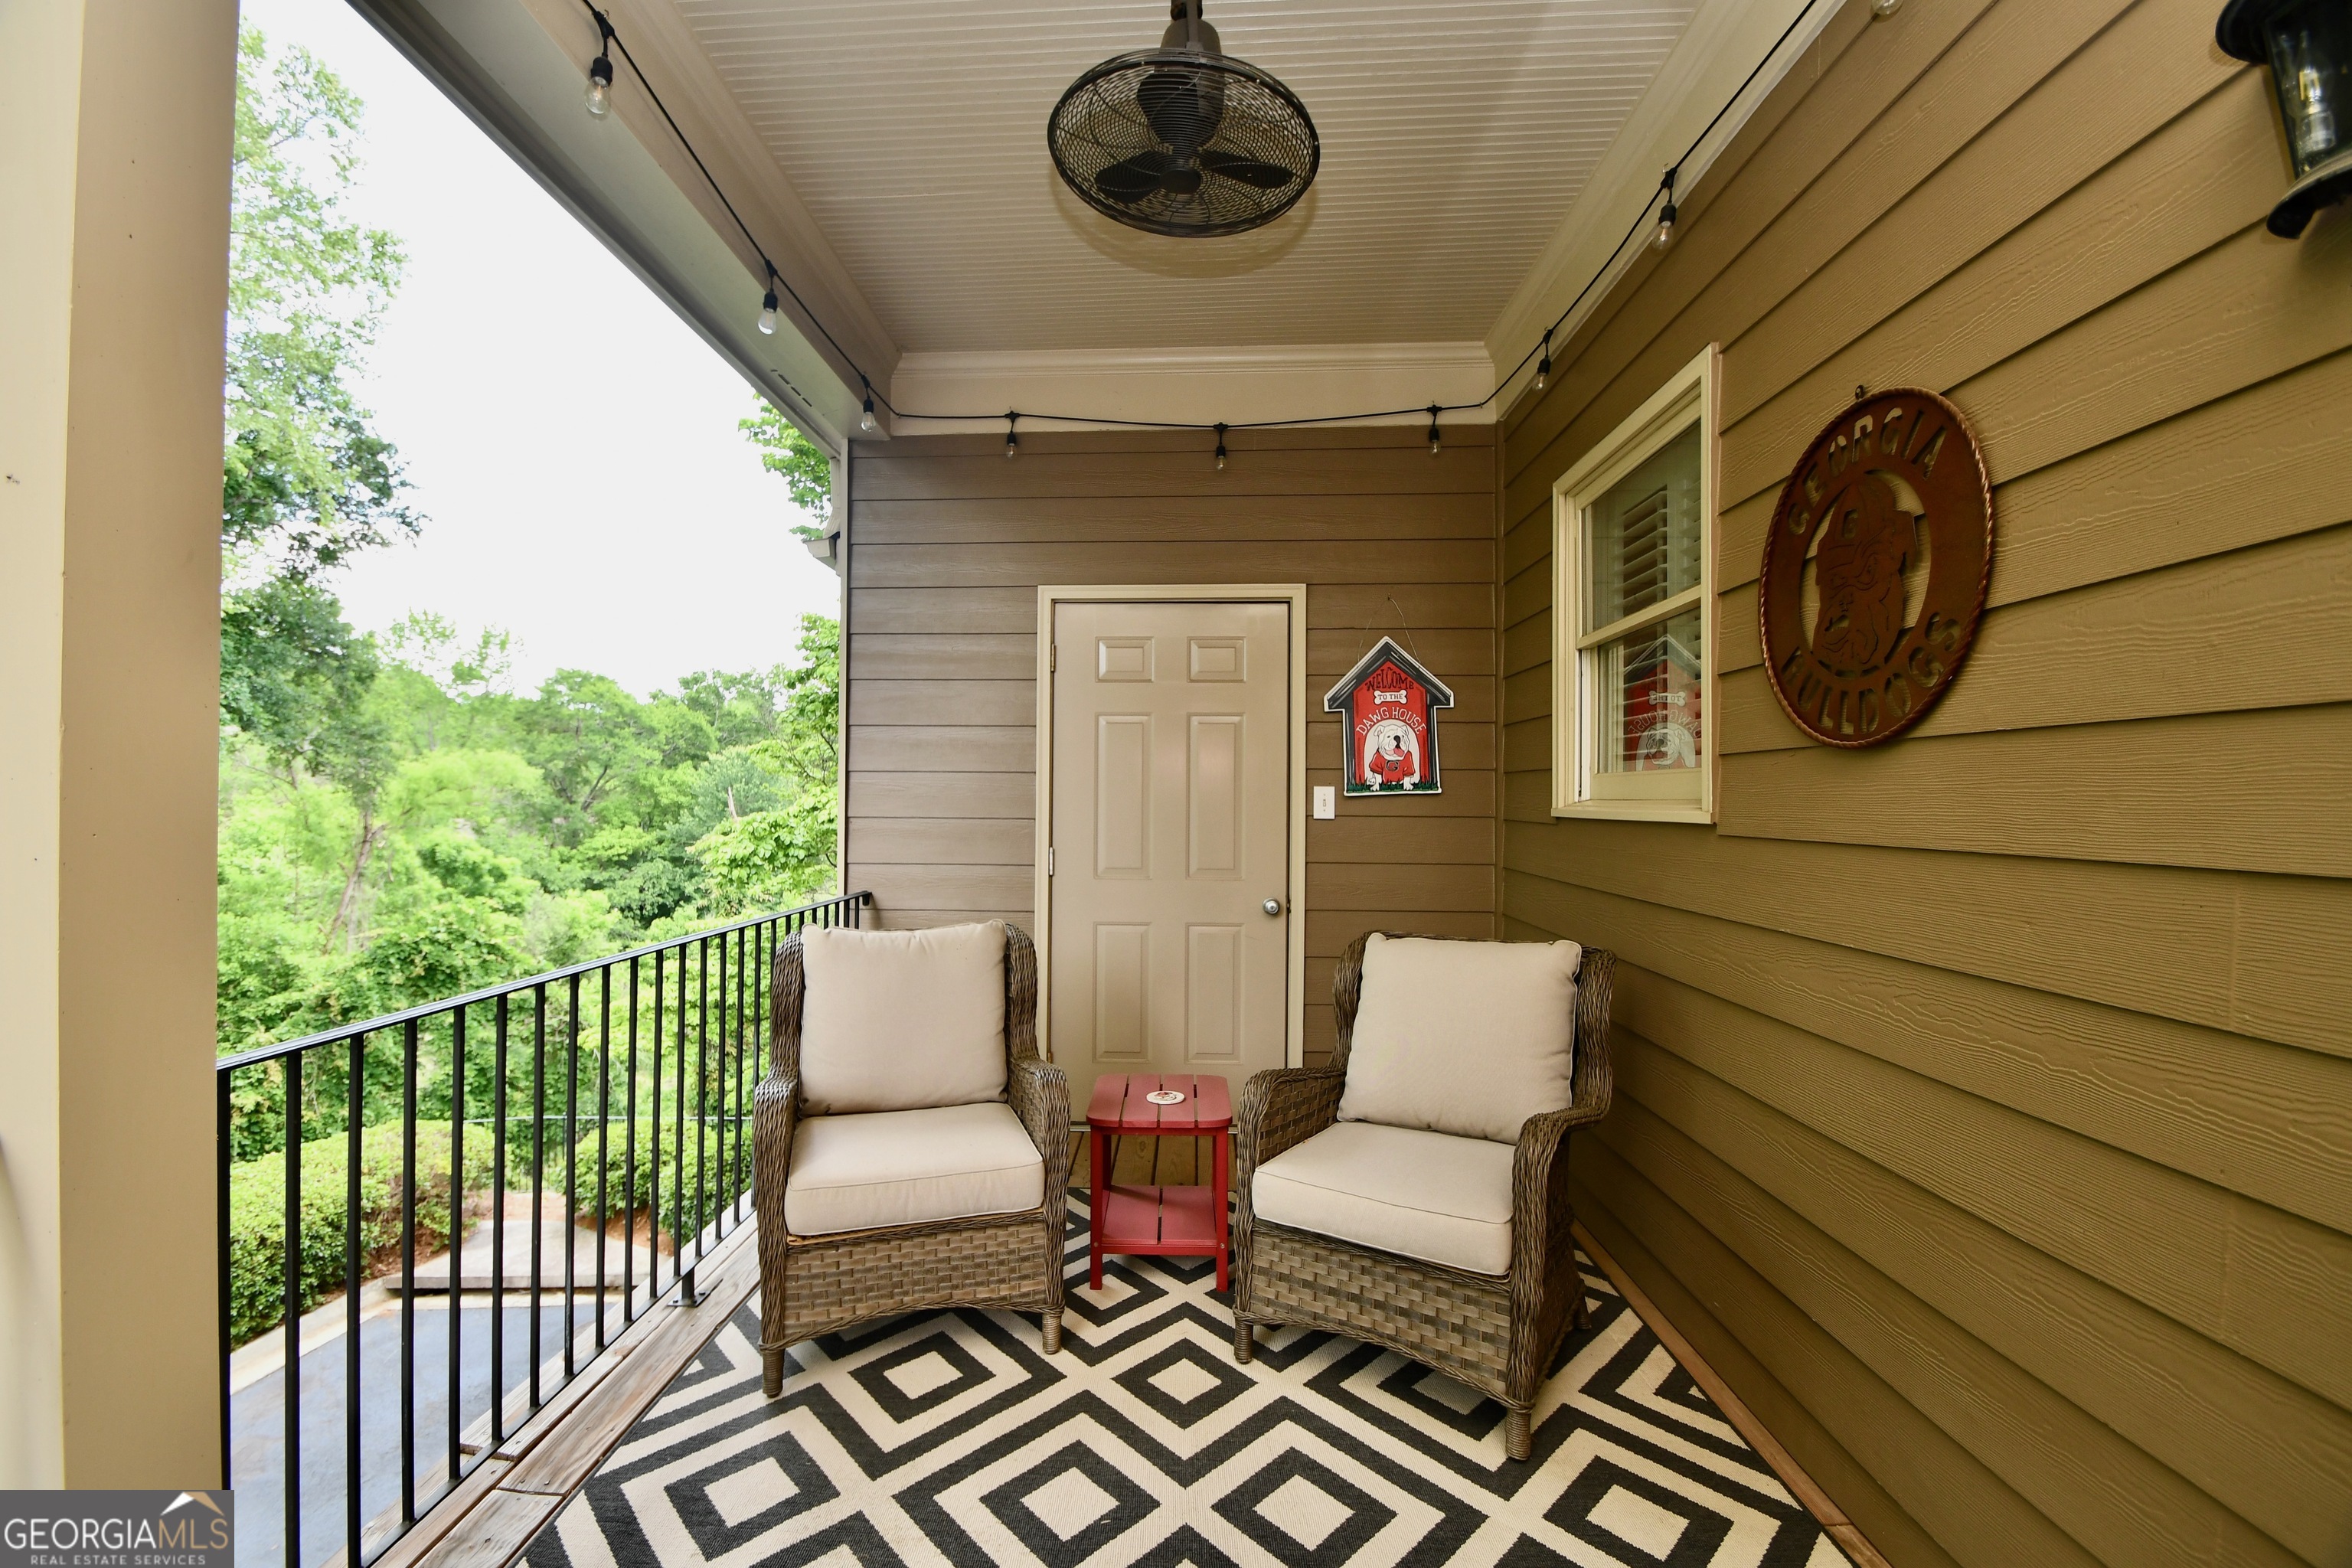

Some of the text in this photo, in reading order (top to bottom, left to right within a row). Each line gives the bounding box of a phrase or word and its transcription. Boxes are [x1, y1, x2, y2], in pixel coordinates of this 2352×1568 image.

[1788, 407, 1948, 535] GEORGIA
[1842, 508, 1858, 540] G
[1365, 666, 1414, 691] WELCOME
[1781, 612, 1961, 735] BULLDOGS
[1356, 706, 1427, 736] DAWG HOUSE
[1386, 760, 1399, 772] G
